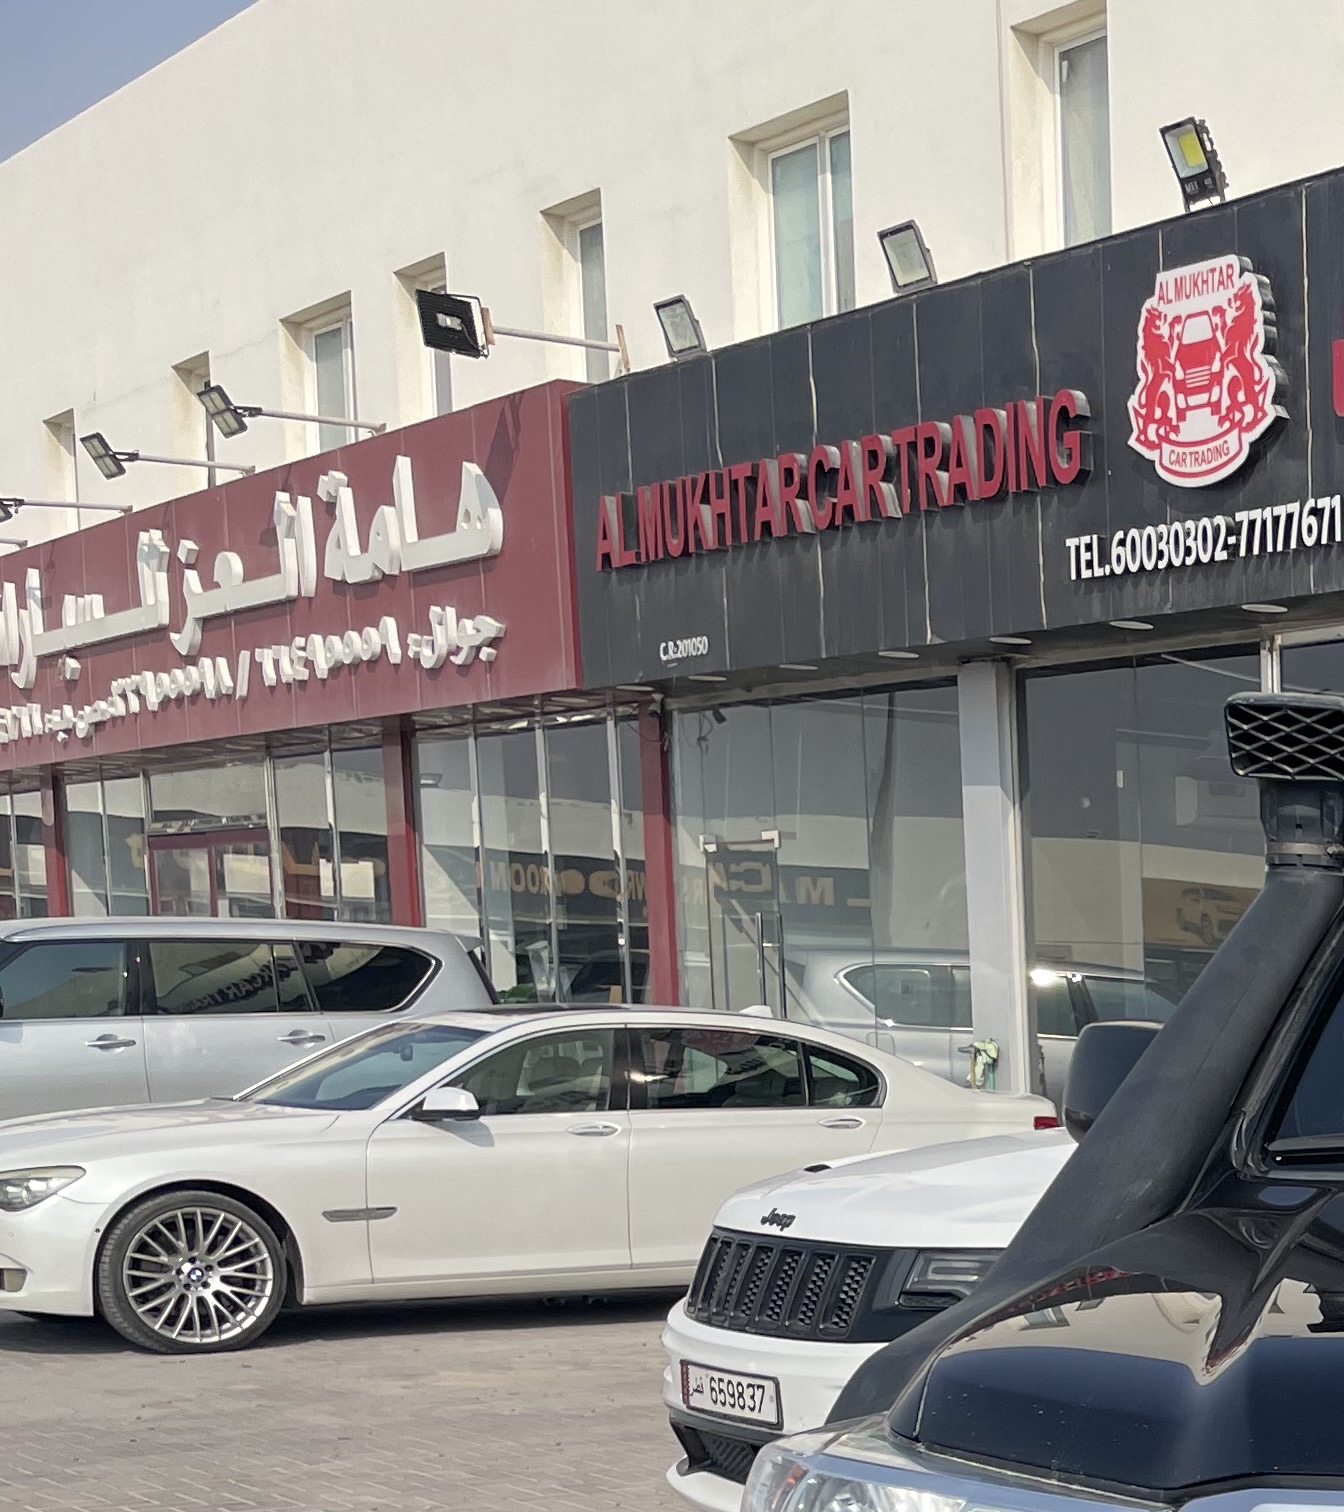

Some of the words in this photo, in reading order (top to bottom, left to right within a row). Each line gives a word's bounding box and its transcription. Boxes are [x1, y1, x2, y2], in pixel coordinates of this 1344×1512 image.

[318, 455, 502, 584] هامة
[1065, 494, 1343, 580] TEL.60030302-77177671
[0, 528, 170, 690] للسيارا
[760, 1207, 796, 1232] Jeep
[709, 1376, 766, 1413] 659837
